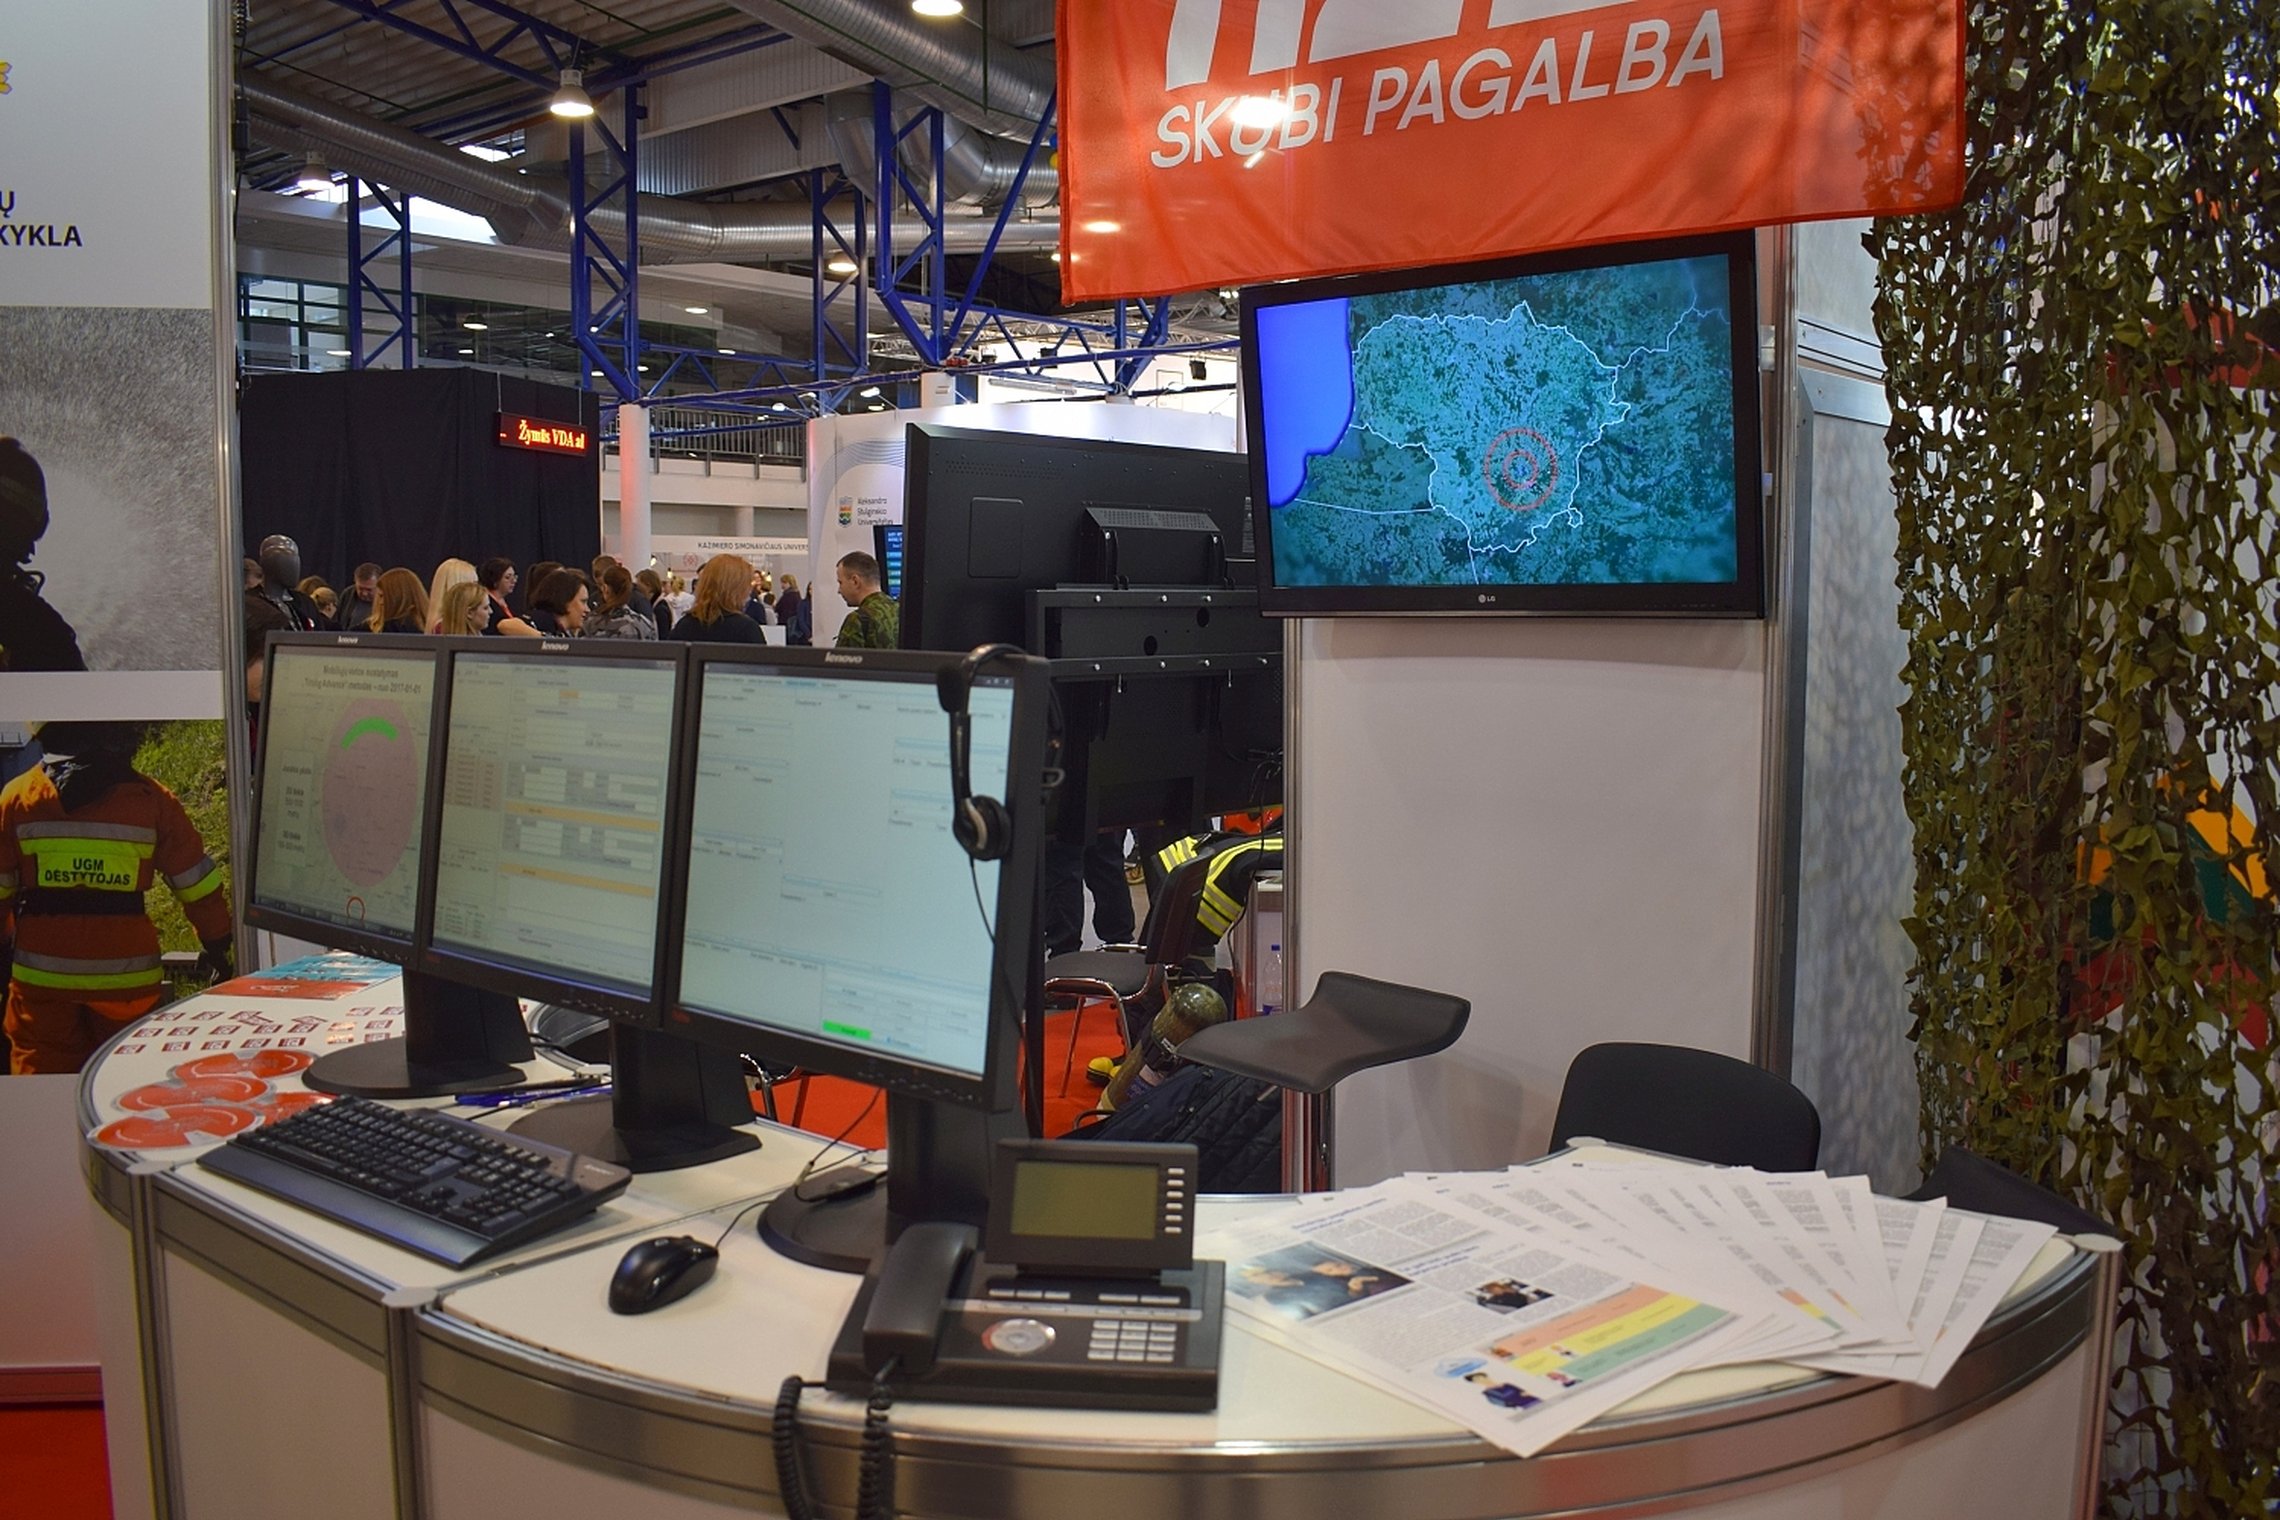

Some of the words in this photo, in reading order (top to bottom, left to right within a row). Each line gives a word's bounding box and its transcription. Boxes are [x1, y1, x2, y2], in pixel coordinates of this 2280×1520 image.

[1151, 77, 1342, 168] SKUBI
[1363, 9, 1725, 135] PAGALBA
[552, 429, 574, 448] VDA
[698, 541, 733, 550] KAZIMIERO
[541, 640, 570, 650] lenovo
[825, 651, 863, 664] lenovo
[73, 858, 104, 871] UGM
